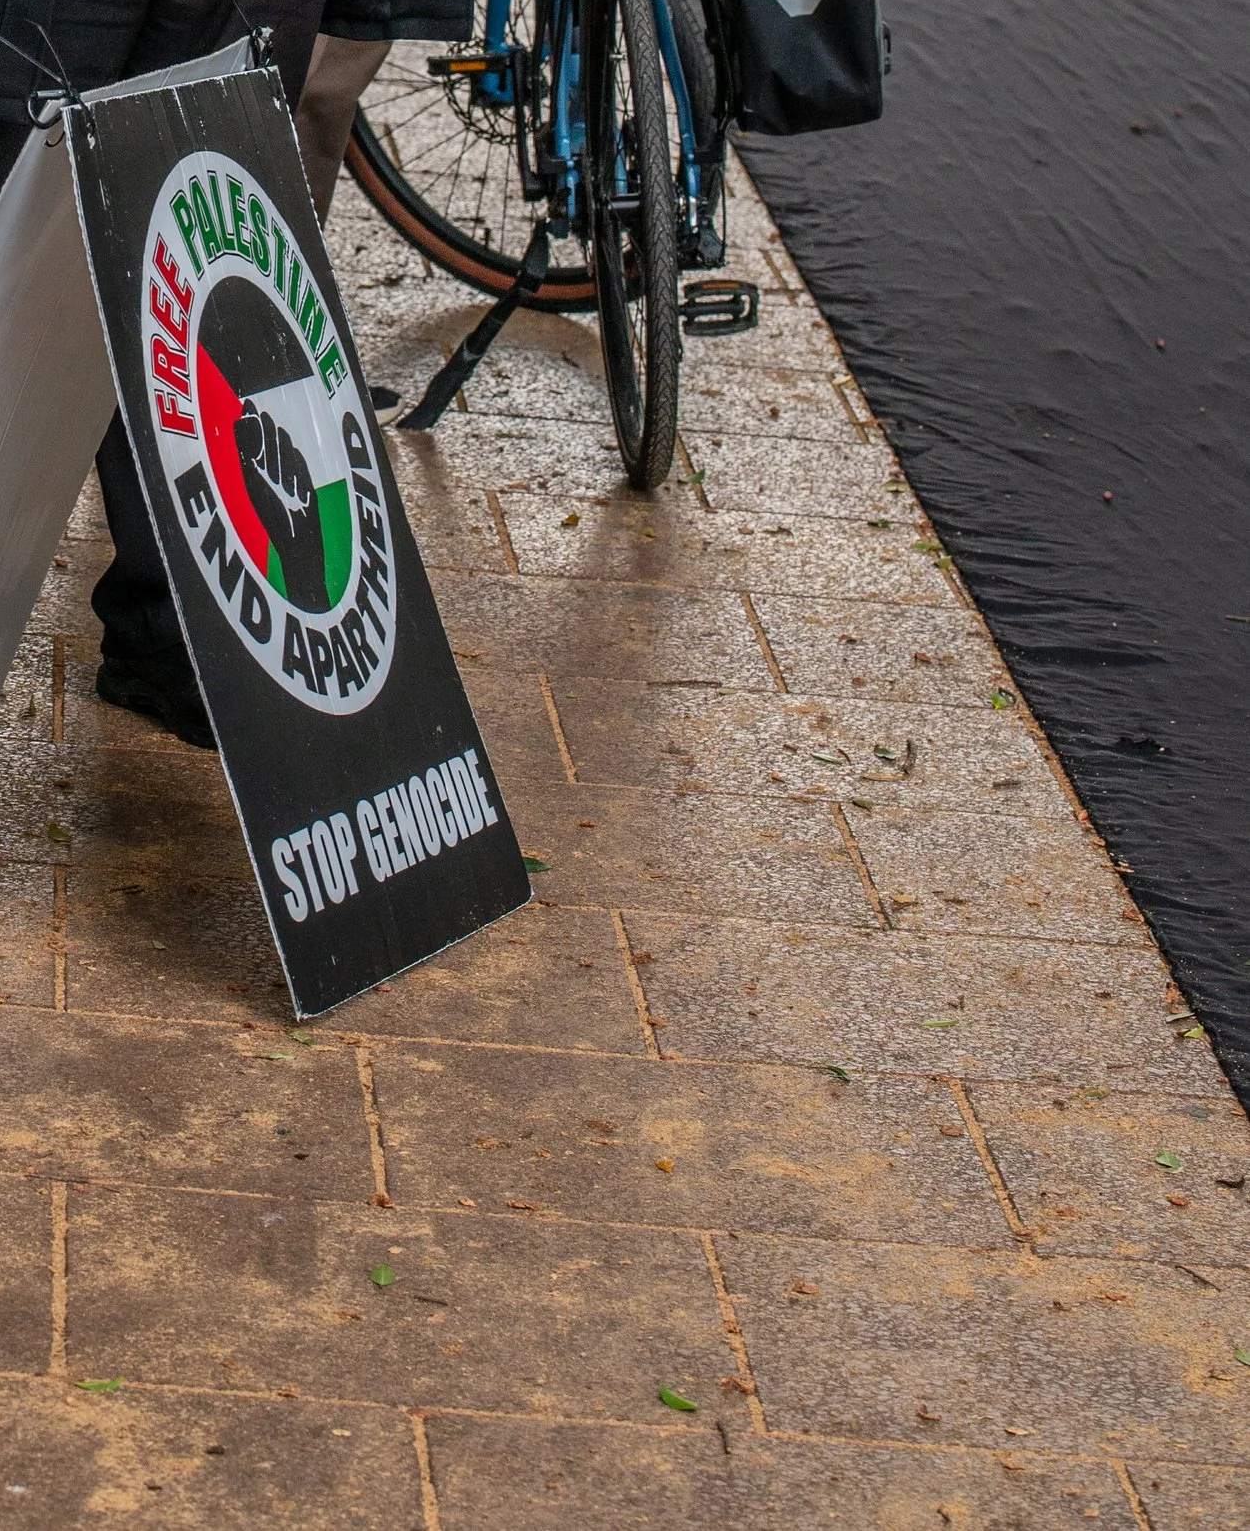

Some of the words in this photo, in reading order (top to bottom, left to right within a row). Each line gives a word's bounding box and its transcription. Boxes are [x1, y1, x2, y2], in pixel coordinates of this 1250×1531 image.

[150, 232, 198, 440] FREE
[169, 170, 349, 400] PALESTINE
[173, 460, 273, 645] END
[282, 411, 390, 698] APARTHEID
[271, 811, 360, 923] STOP
[356, 747, 499, 883] GENOCIDE
